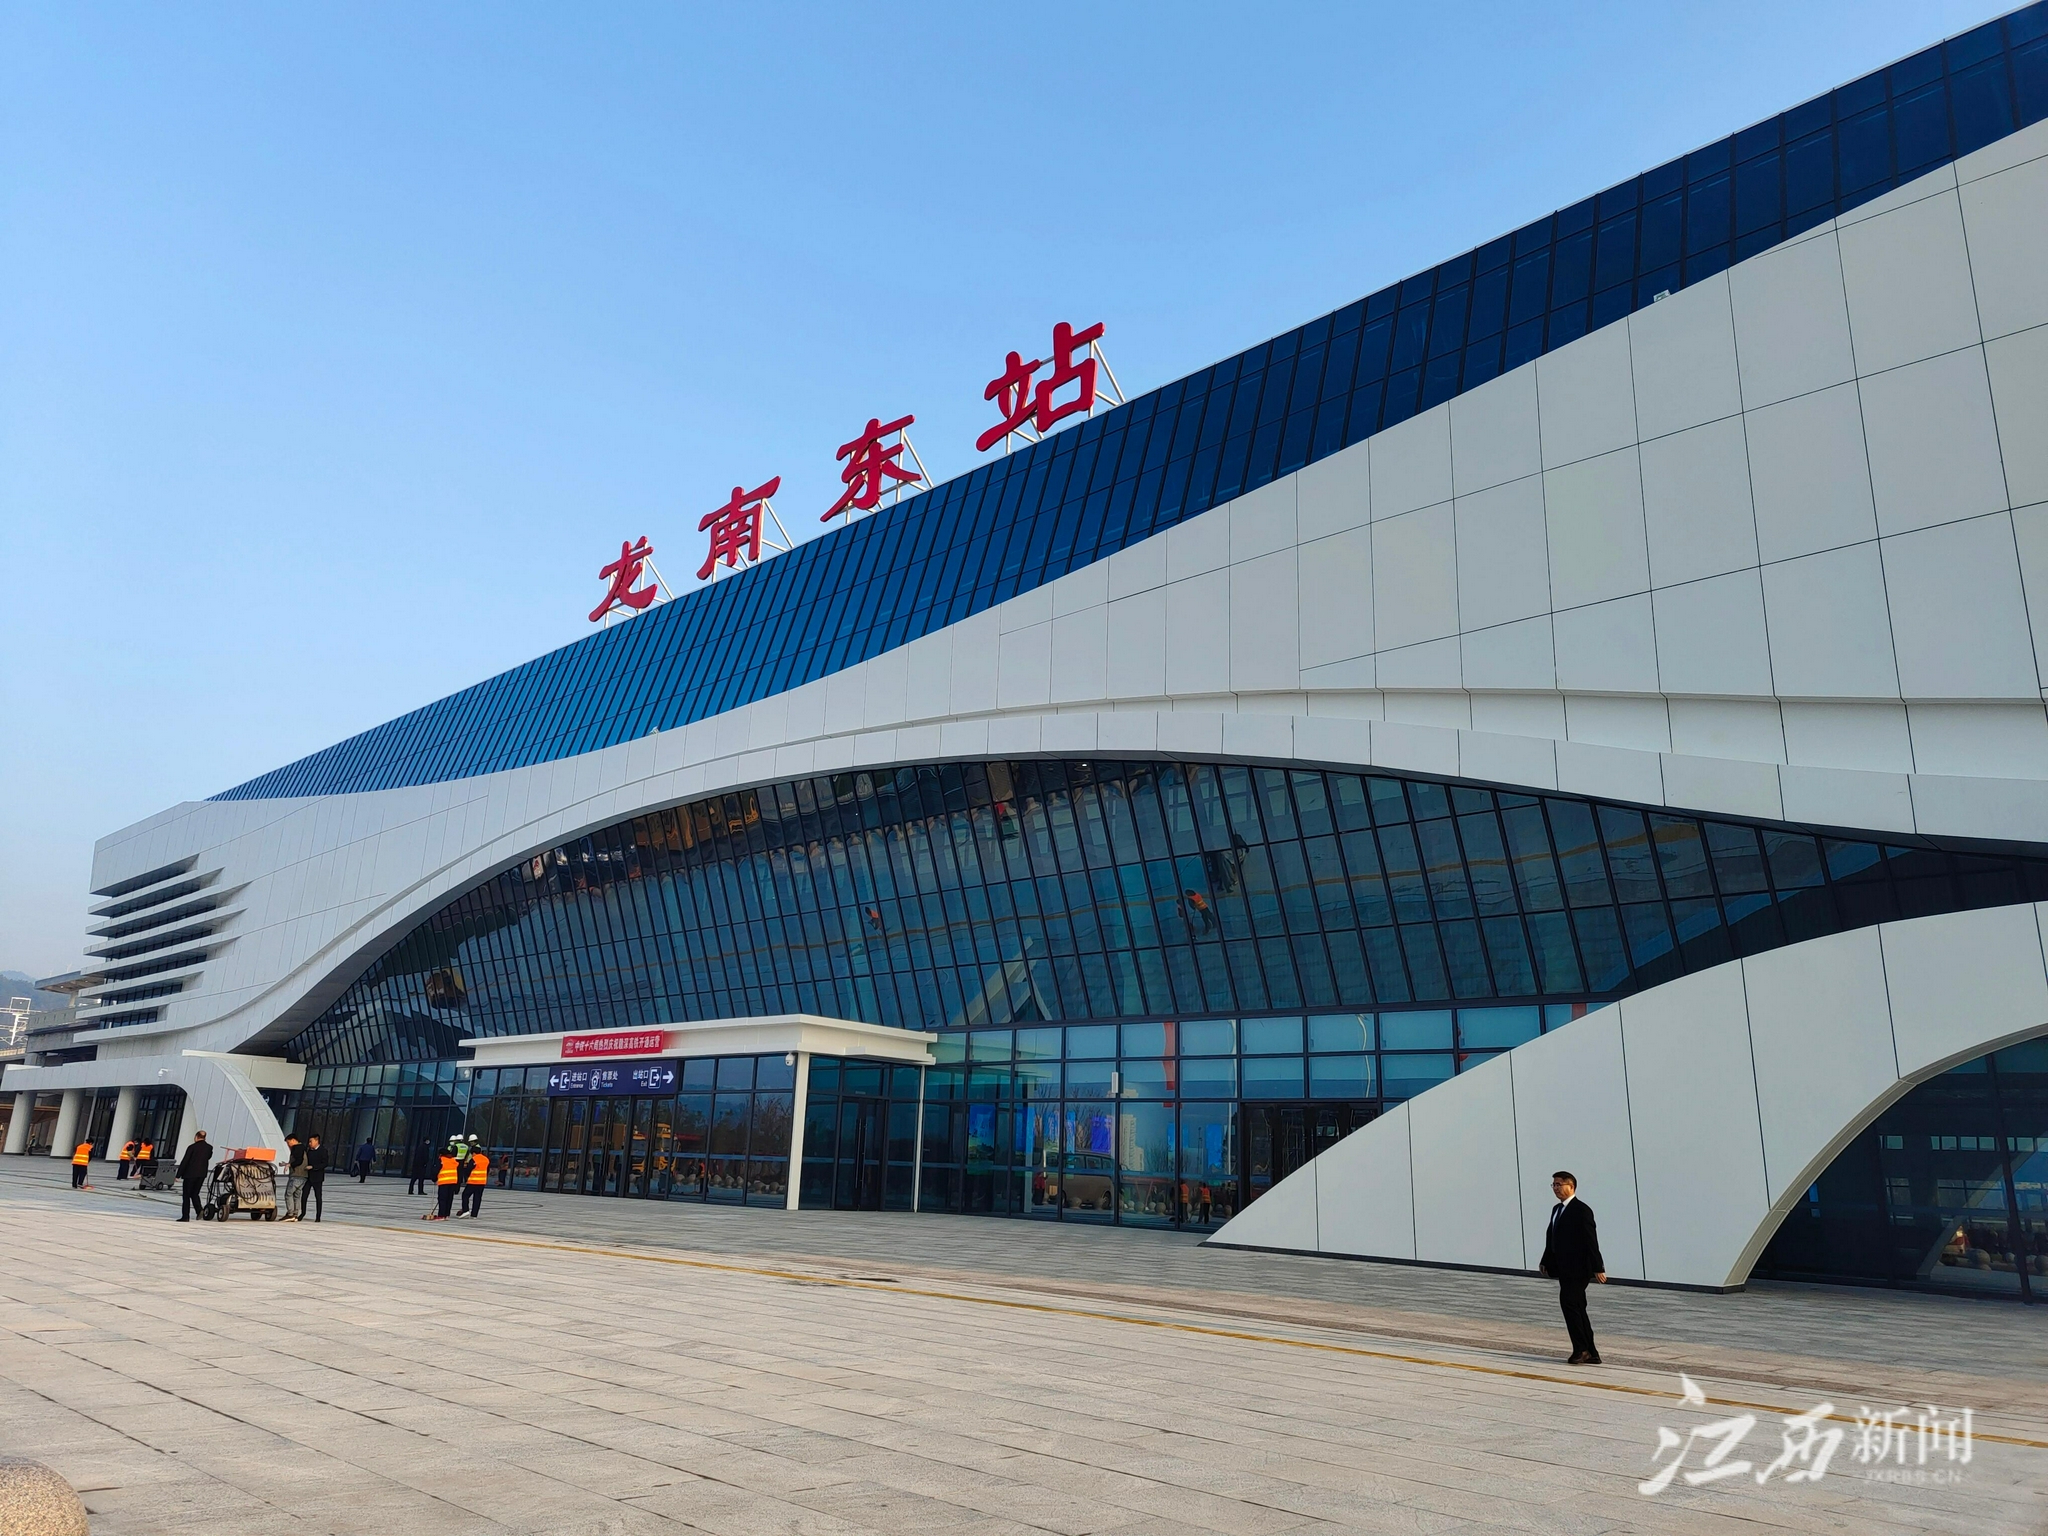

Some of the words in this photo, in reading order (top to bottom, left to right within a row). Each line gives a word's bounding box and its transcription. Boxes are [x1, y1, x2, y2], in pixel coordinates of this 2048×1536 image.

[589, 321, 1105, 622] 龙南东站
[571, 1072, 588, 1082] 进站口
[602, 1070, 618, 1080] 售票处
[632, 1070, 649, 1080] 出站口
